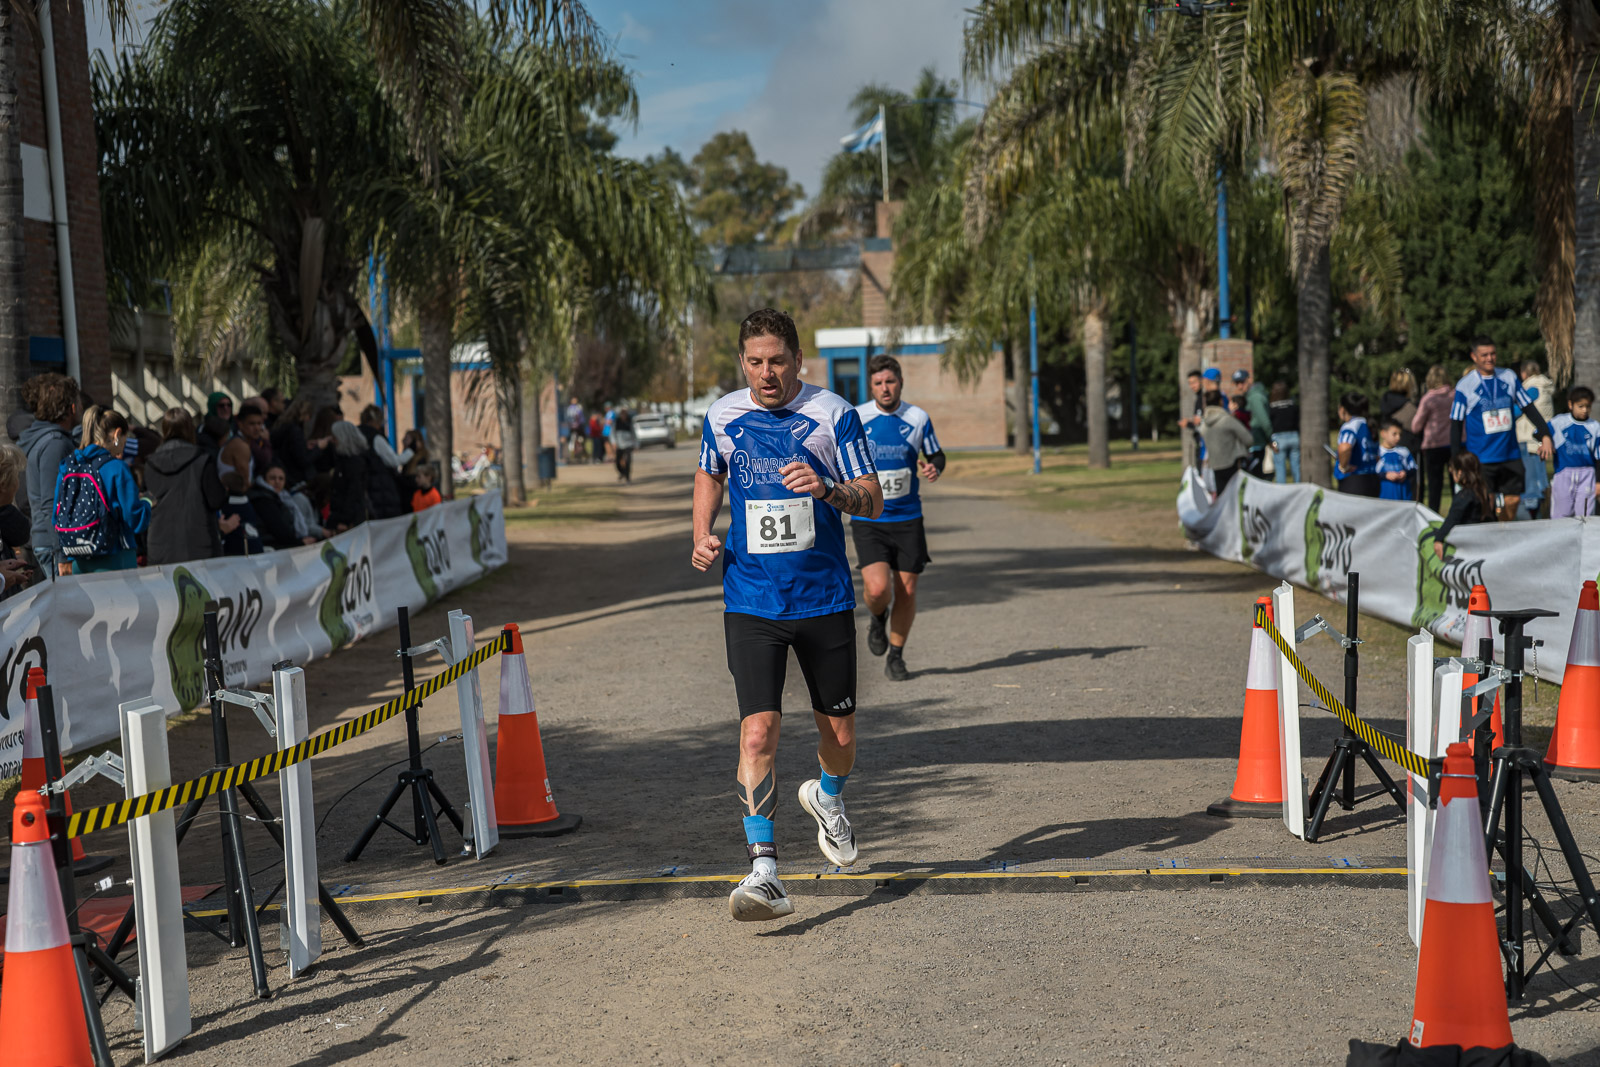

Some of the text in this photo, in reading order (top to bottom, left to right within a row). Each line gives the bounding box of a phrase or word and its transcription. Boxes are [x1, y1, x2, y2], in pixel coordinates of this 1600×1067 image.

[733, 449, 754, 489] 3
[882, 477, 903, 492] 45
[760, 514, 797, 541] 81
